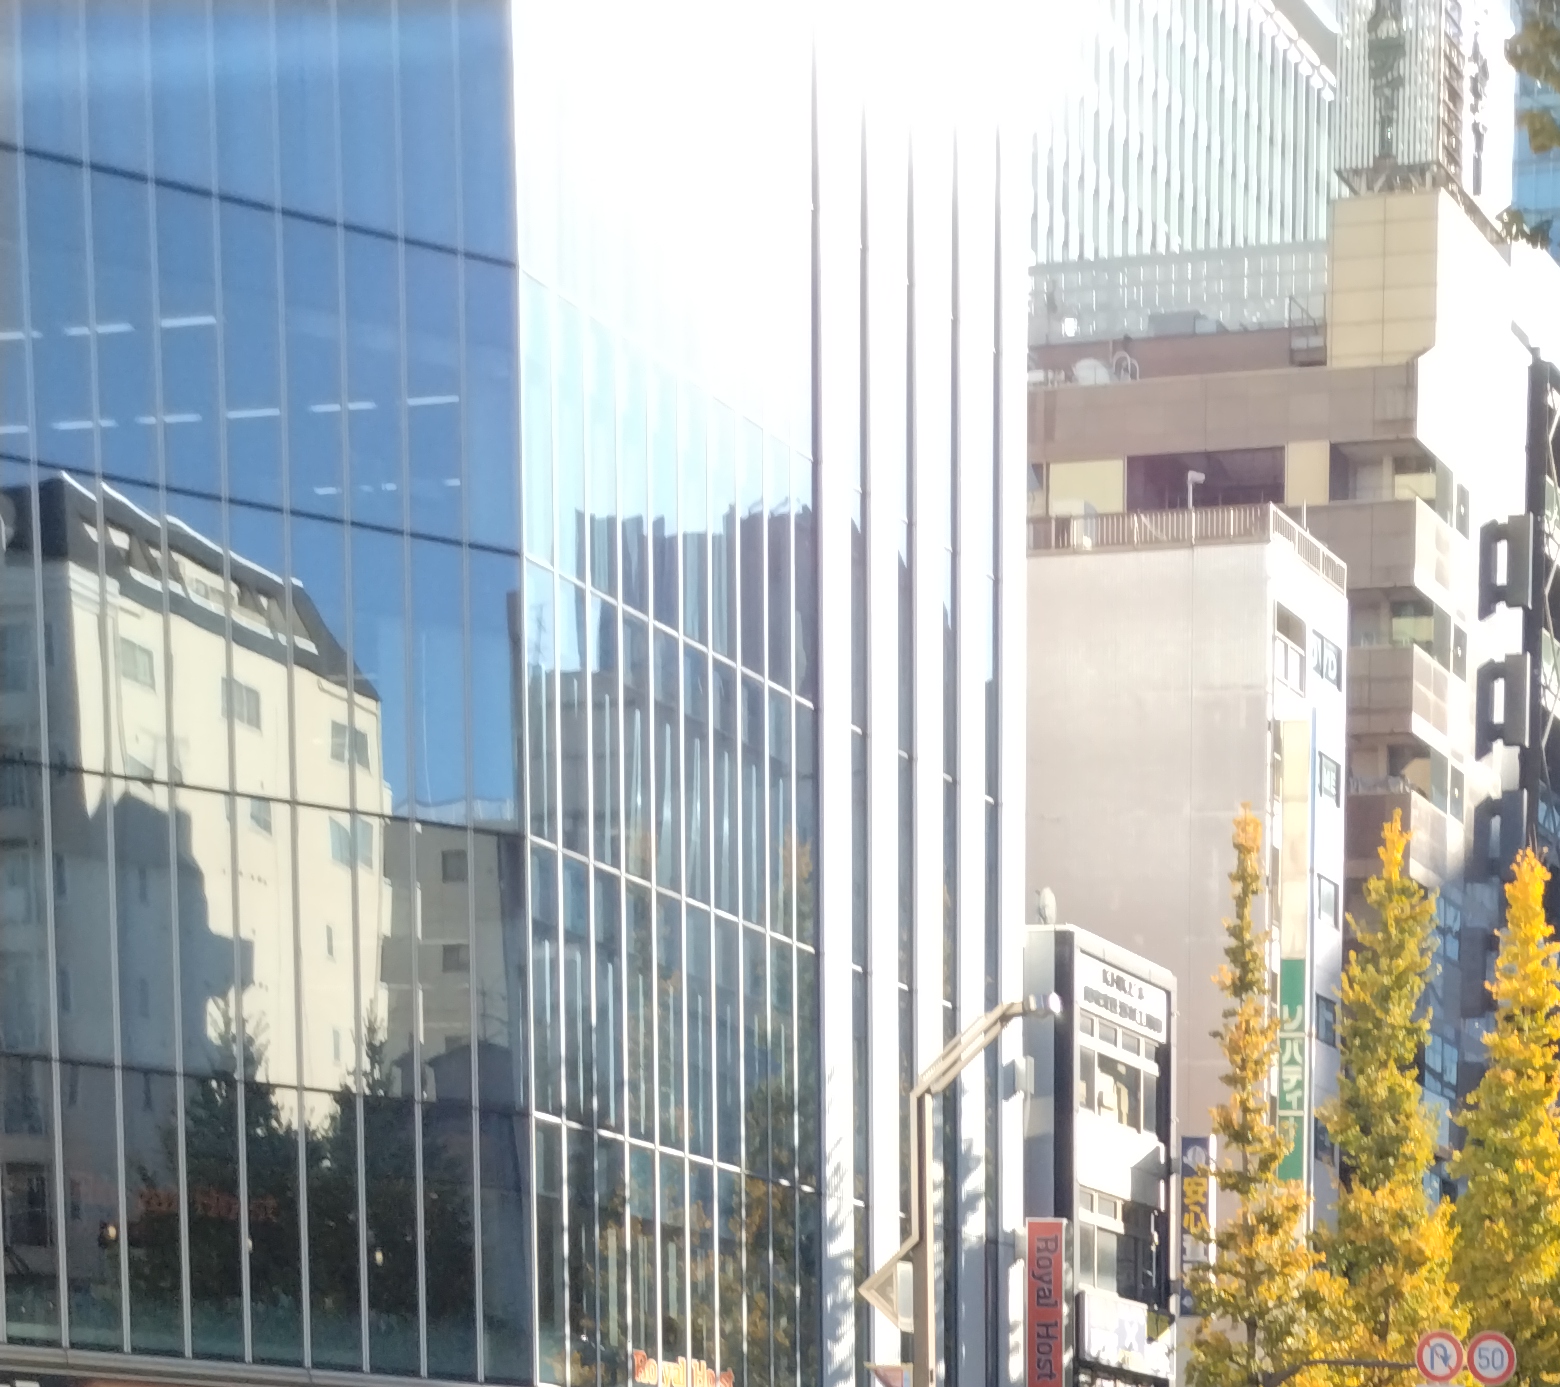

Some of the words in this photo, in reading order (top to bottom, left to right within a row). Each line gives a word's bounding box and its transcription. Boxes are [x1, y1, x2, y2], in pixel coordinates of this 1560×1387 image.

[1031, 1234, 1059, 1309] Royal
[1035, 1320, 1058, 1382] Host
[1477, 1346, 1505, 1372] 50
